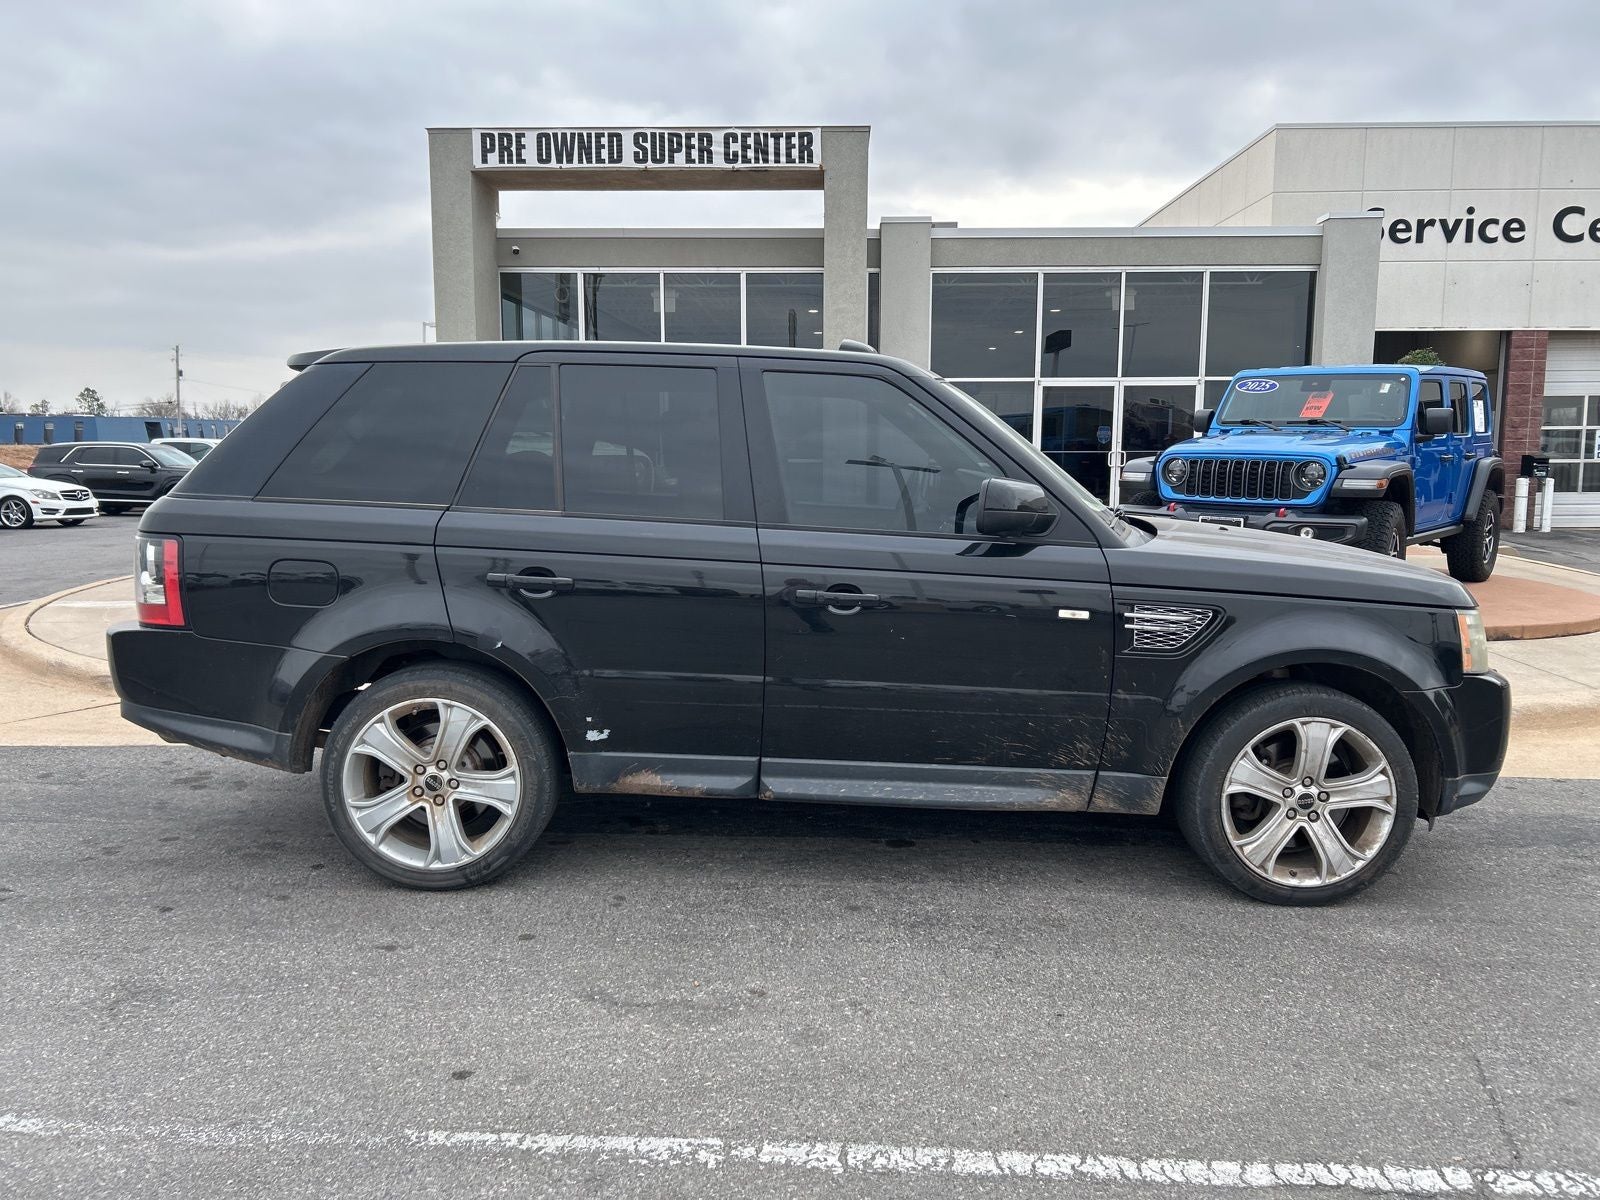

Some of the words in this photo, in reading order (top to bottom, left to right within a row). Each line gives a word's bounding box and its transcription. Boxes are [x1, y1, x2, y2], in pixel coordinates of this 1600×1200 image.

[480, 132, 527, 165] PRE
[536, 132, 623, 165] OWNED
[633, 131, 714, 165] SUPER
[723, 131, 814, 165] CENTER
[1367, 205, 1526, 244] ervice
[1242, 381, 1271, 391] 2025
